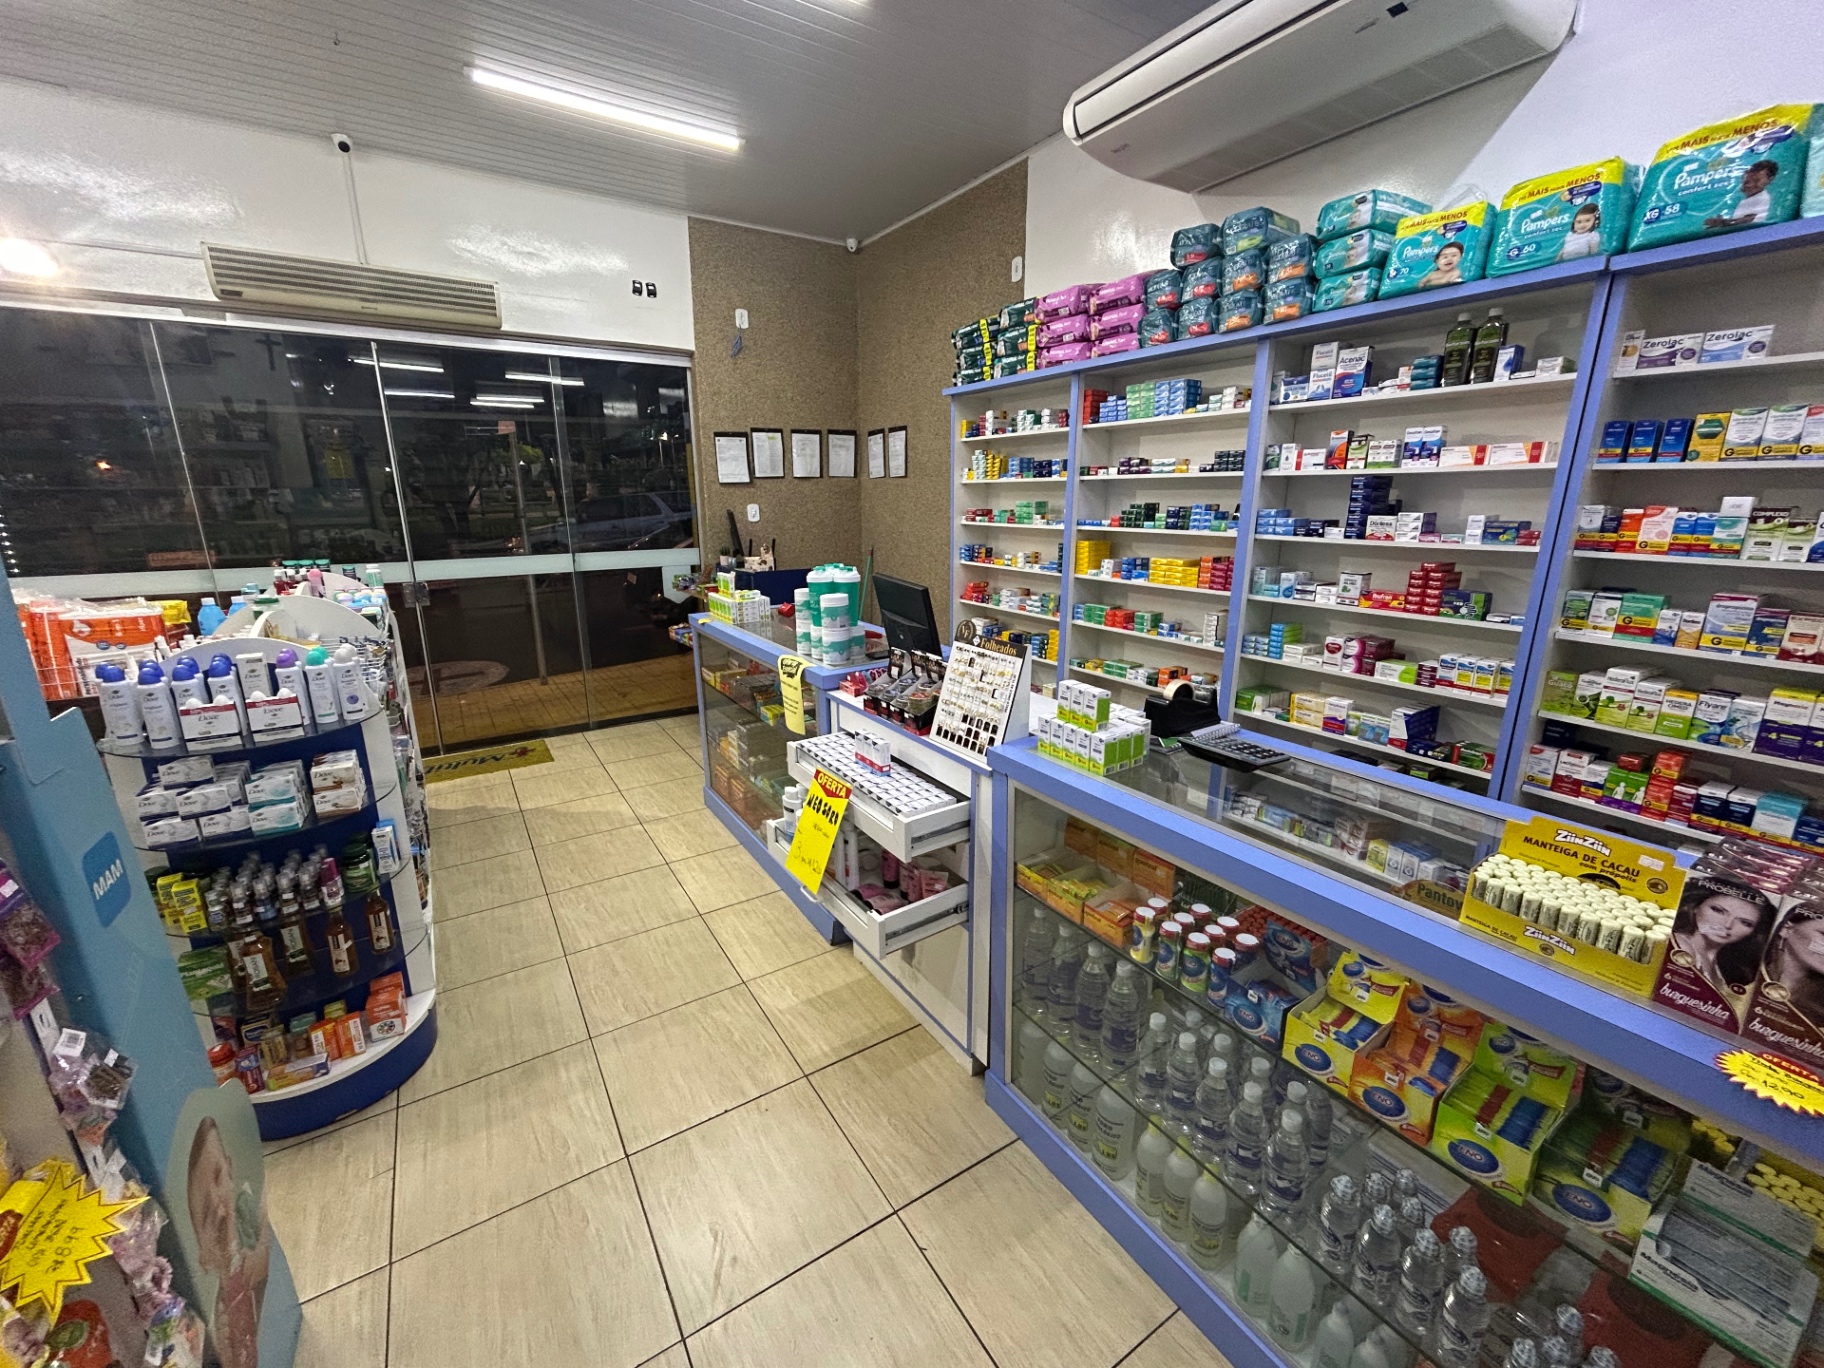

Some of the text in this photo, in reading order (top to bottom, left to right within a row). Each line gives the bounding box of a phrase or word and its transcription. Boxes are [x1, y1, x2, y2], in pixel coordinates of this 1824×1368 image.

[1733, 119, 1778, 136] MENOS
[1527, 186, 1549, 199] MAIS
[1566, 172, 1601, 188] MENOS
[1439, 211, 1468, 223] MENOS
[1665, 203, 1680, 215] 58
[1520, 212, 1571, 234] Pampers
[1522, 243, 1537, 254] 60
[1643, 337, 1684, 350] Zerolac
[1706, 330, 1753, 342] Zerolac
[980, 637, 1018, 656] Folheados
[314, 771, 333, 779] Dove
[817, 772, 847, 799] OFERTA
[1523, 836, 1640, 878] MANTEIGA DE CACAU
[92, 858, 124, 900] MAM
[1579, 861, 1637, 883] com própolis
[1698, 878, 1766, 905] PROBELLE
[1659, 982, 1730, 1020] burguesinha
[1372, 1092, 1393, 1107] ENO
[1458, 1145, 1484, 1163] ENO
[1571, 1192, 1592, 1209] ENO
